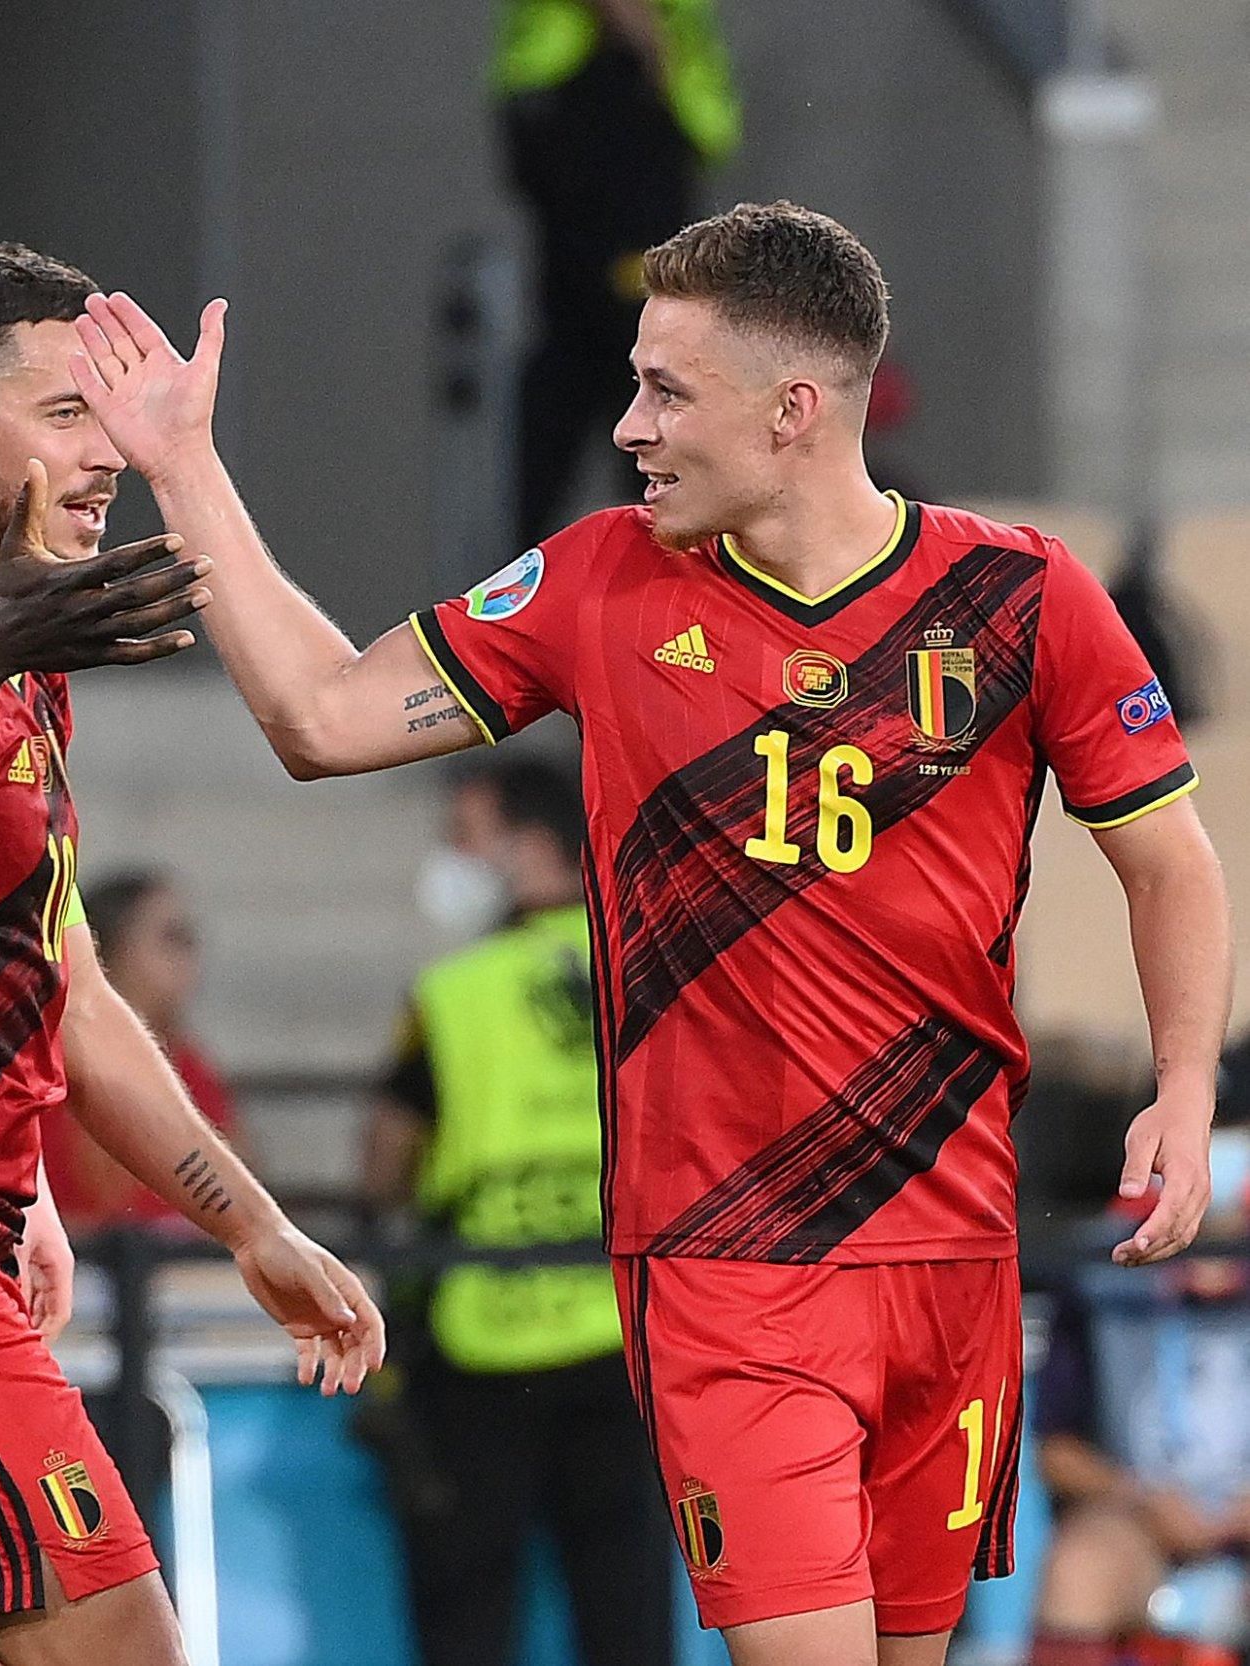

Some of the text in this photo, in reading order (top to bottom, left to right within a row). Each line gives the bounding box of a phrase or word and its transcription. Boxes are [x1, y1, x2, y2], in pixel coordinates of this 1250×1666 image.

[653, 648, 716, 674] adidas
[918, 763, 971, 776] 125 YEARS
[744, 729, 874, 874] 16
